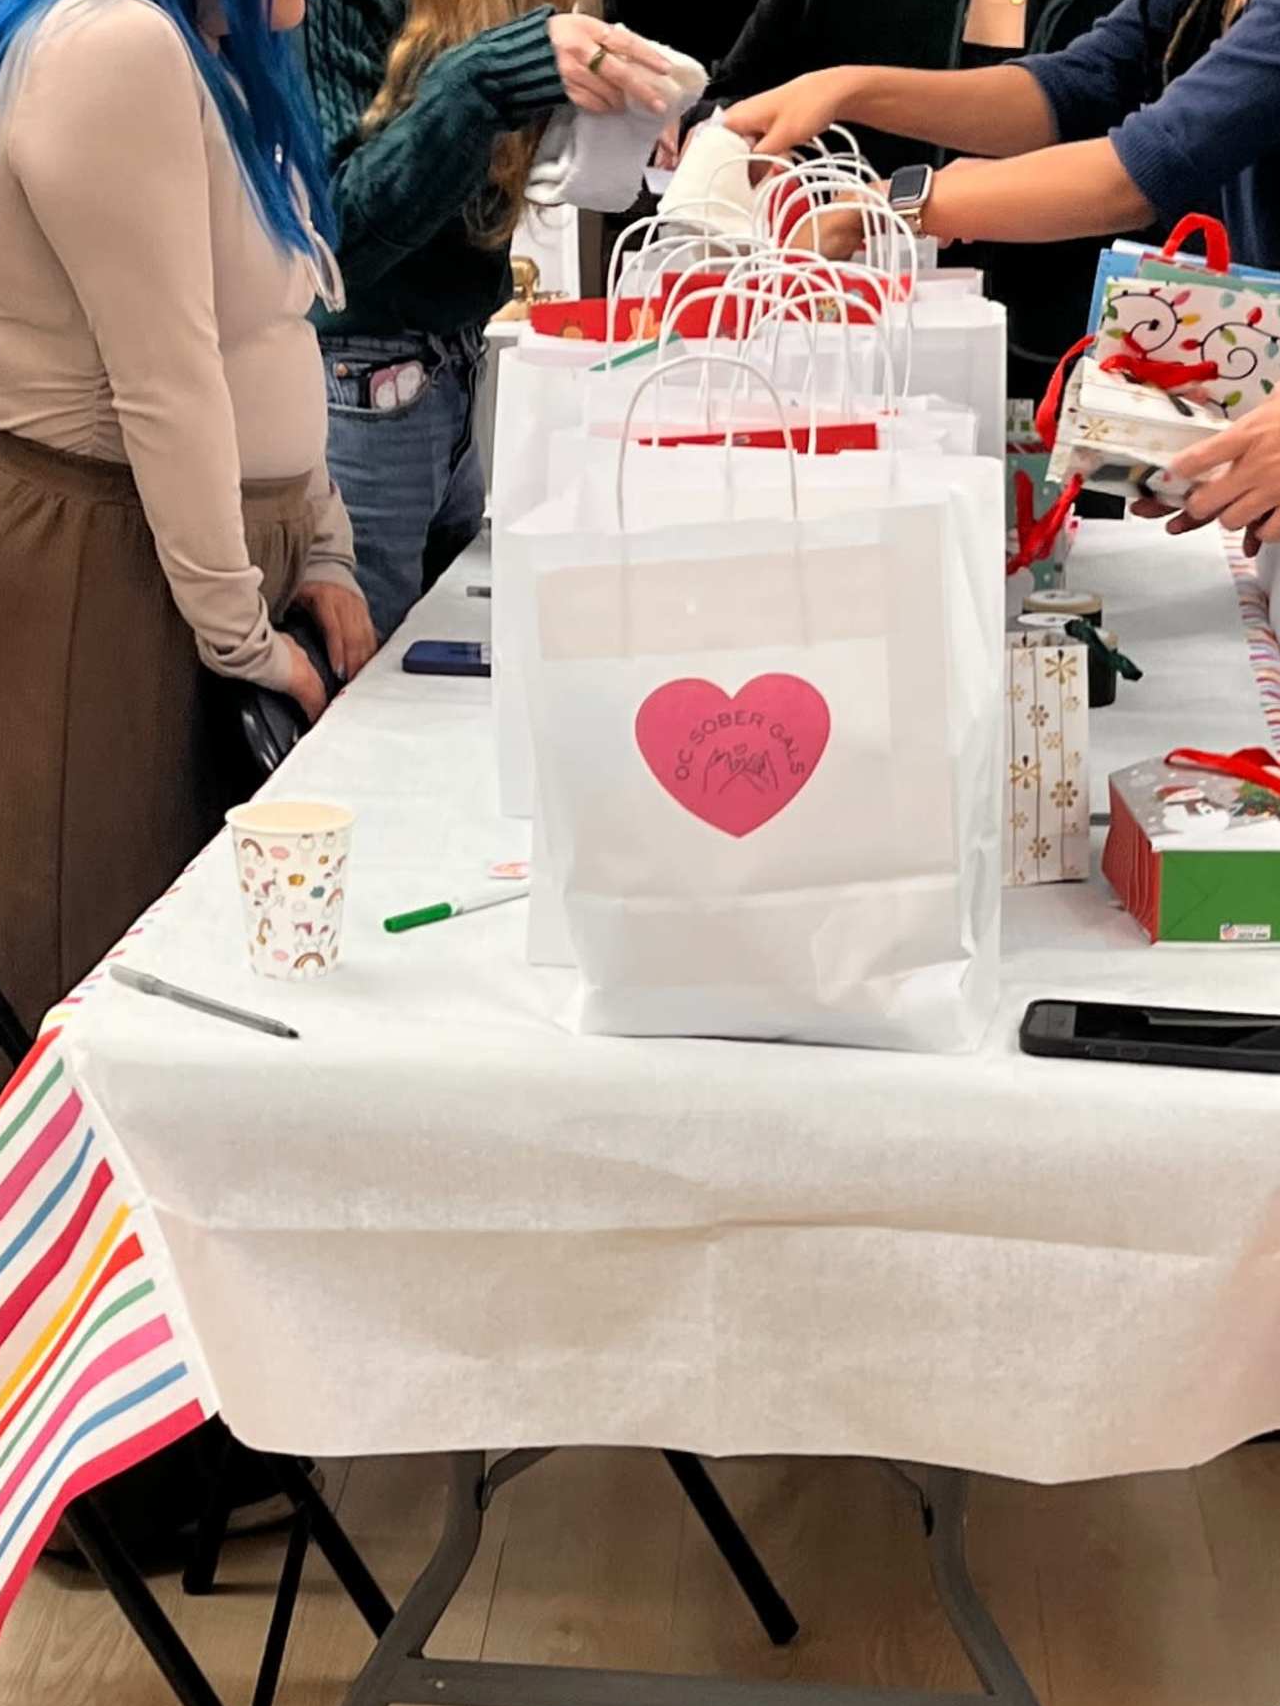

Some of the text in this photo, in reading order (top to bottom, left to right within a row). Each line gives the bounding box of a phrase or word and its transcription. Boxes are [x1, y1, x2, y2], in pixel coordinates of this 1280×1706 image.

[675, 709, 805, 781] OC SOBER GALS
